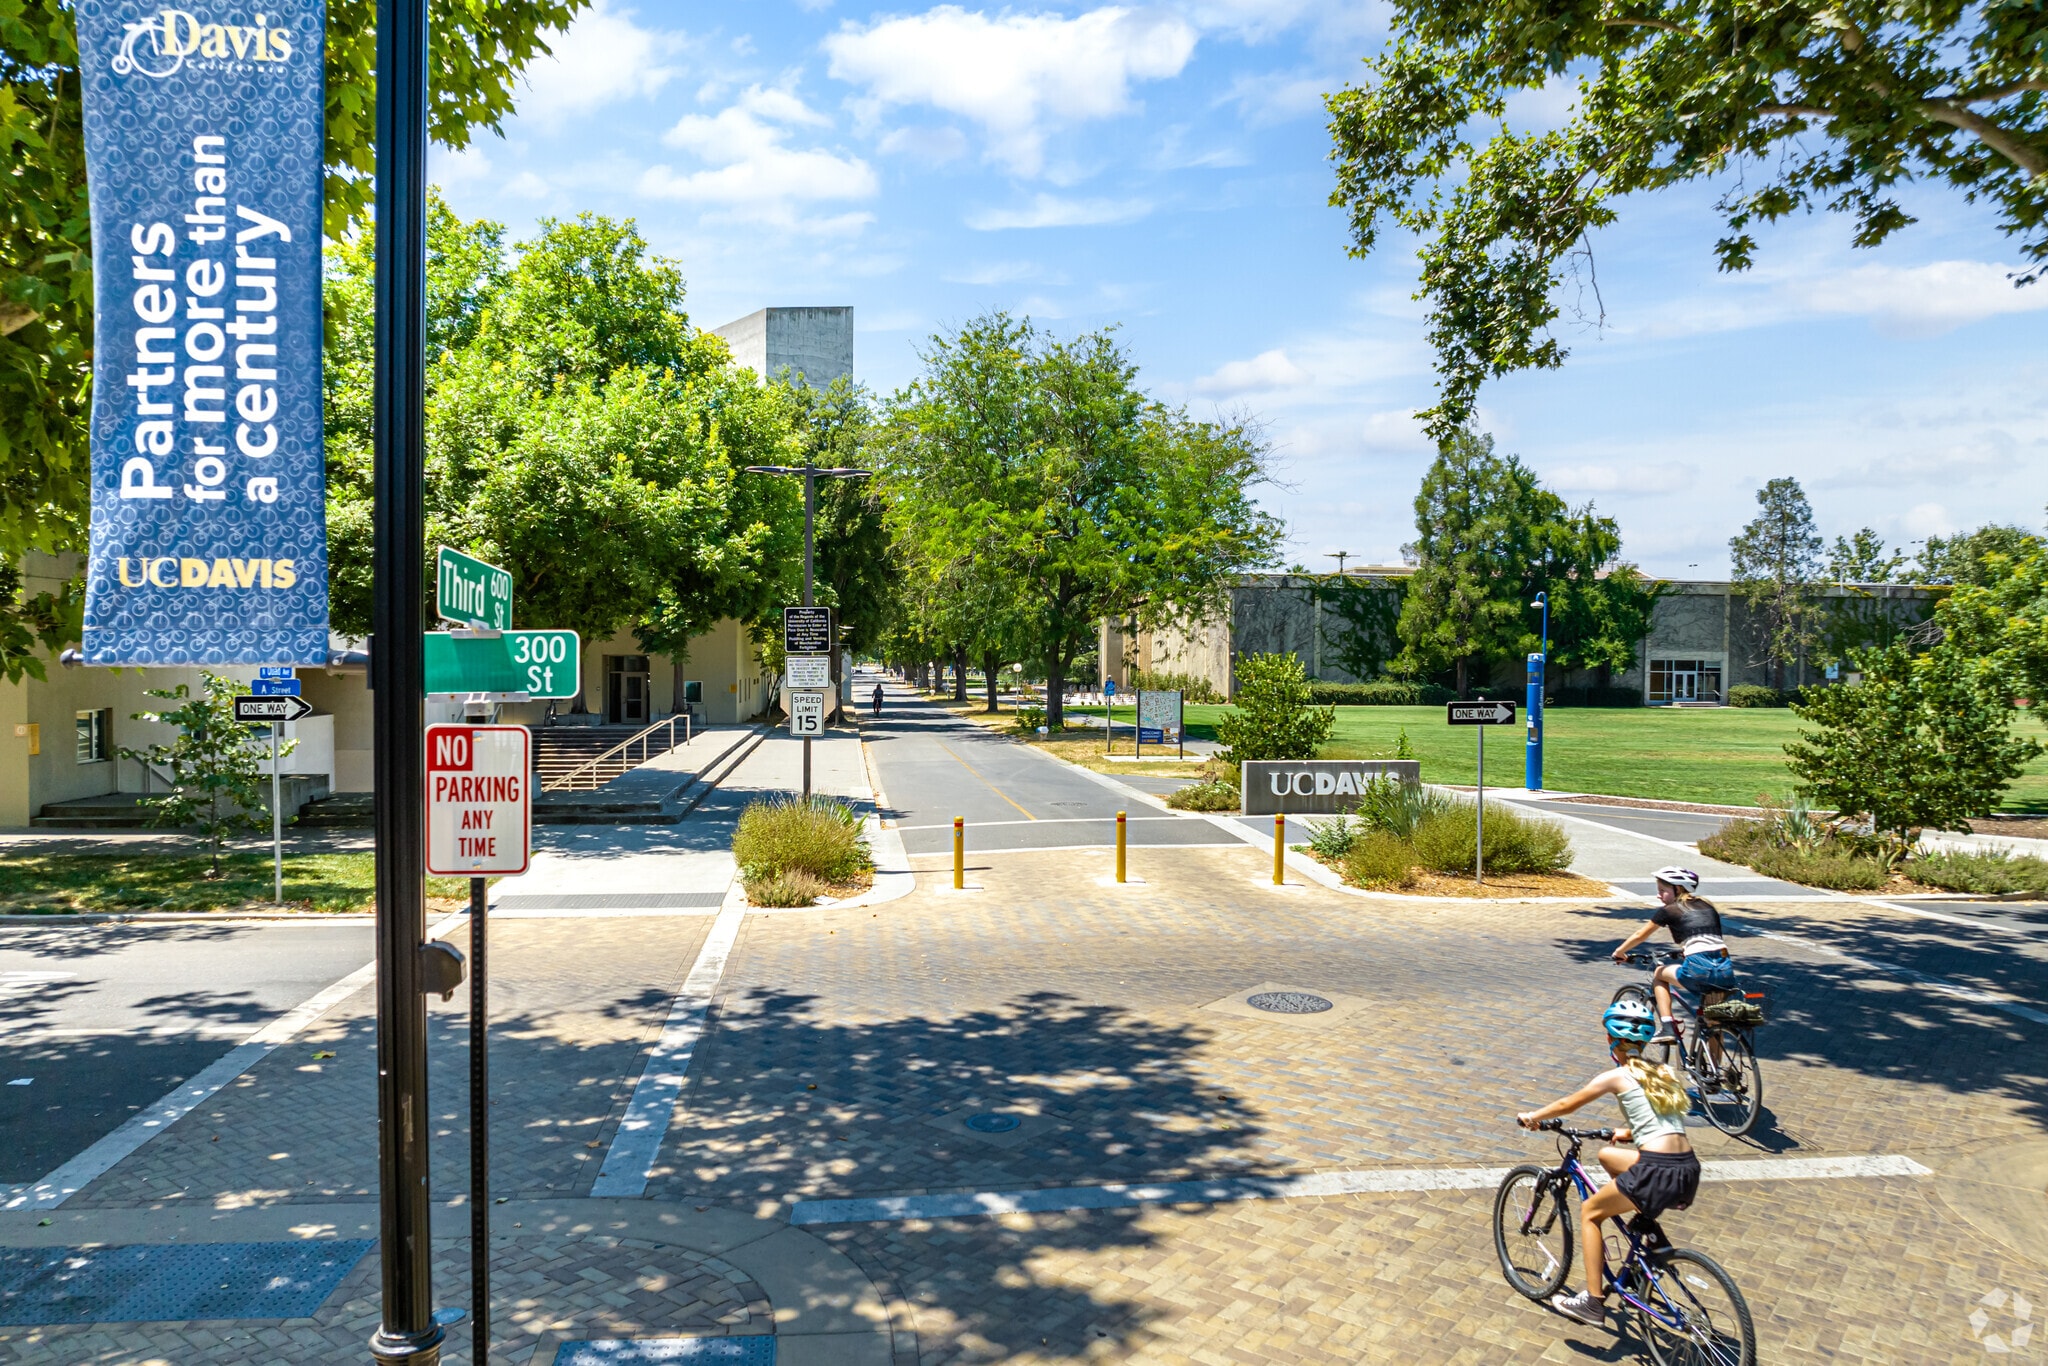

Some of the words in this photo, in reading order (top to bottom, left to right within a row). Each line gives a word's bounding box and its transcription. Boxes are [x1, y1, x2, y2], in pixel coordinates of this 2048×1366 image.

[159, 10, 292, 62] Davis
[186, 59, 284, 74] California
[185, 135, 226, 245] than
[184, 259, 226, 422] more
[226, 204, 291, 458] century
[120, 223, 177, 499] Partners
[184, 437, 226, 503] for
[247, 477, 278, 504] a
[442, 559, 485, 618] Third
[490, 571, 509, 601] 600
[494, 602, 504, 630] St
[514, 635, 567, 663] 300
[261, 684, 267, 694] A
[271, 686, 291, 694] Street
[526, 665, 554, 692] St
[242, 704, 263, 714] ONE
[267, 704, 288, 714] WAY
[1455, 710, 1474, 718] ONE
[1477, 710, 1496, 718] WAY
[797, 715, 817, 731] 15
[436, 735, 468, 766] NO
[436, 776, 519, 803] PARKING
[462, 810, 494, 829] ANY
[458, 838, 496, 857] TIME
